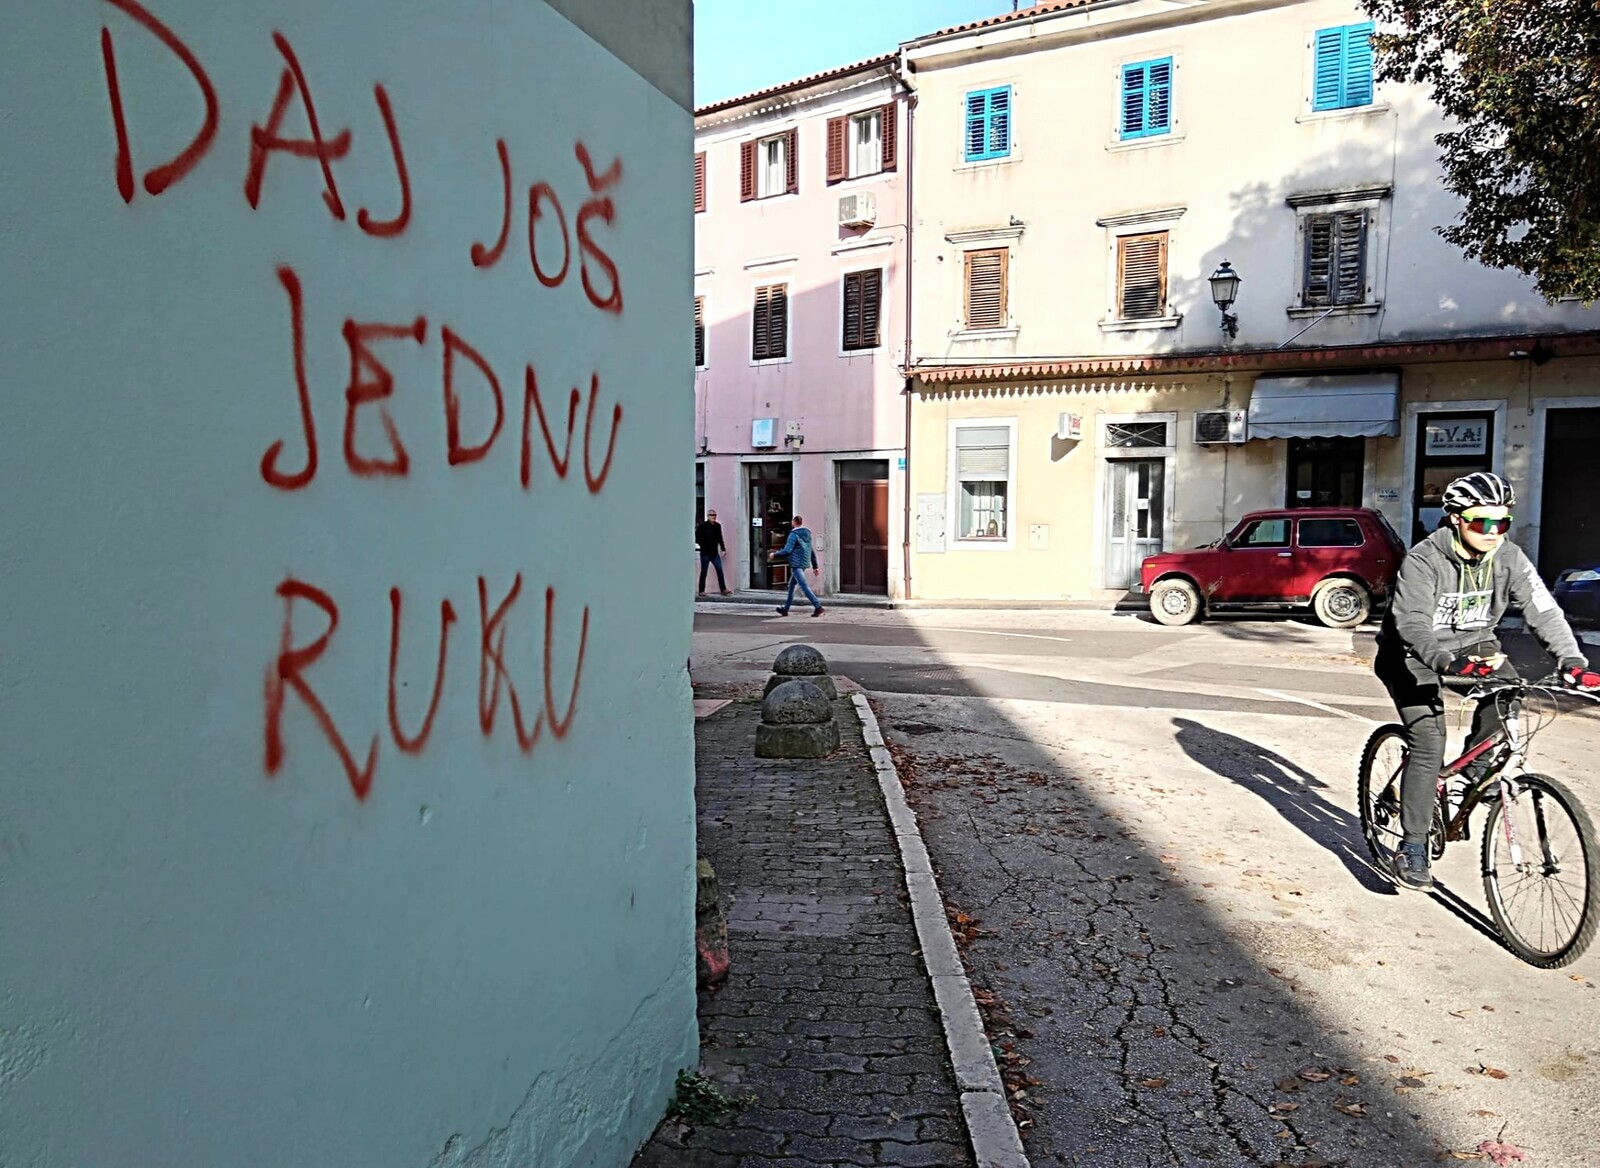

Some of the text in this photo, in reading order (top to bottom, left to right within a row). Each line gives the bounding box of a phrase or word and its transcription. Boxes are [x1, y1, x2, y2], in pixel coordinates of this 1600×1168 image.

[102, 0, 622, 314] DAJ JOŠ
[260, 264, 623, 495] JEDNU
[263, 572, 589, 802] RUKU
